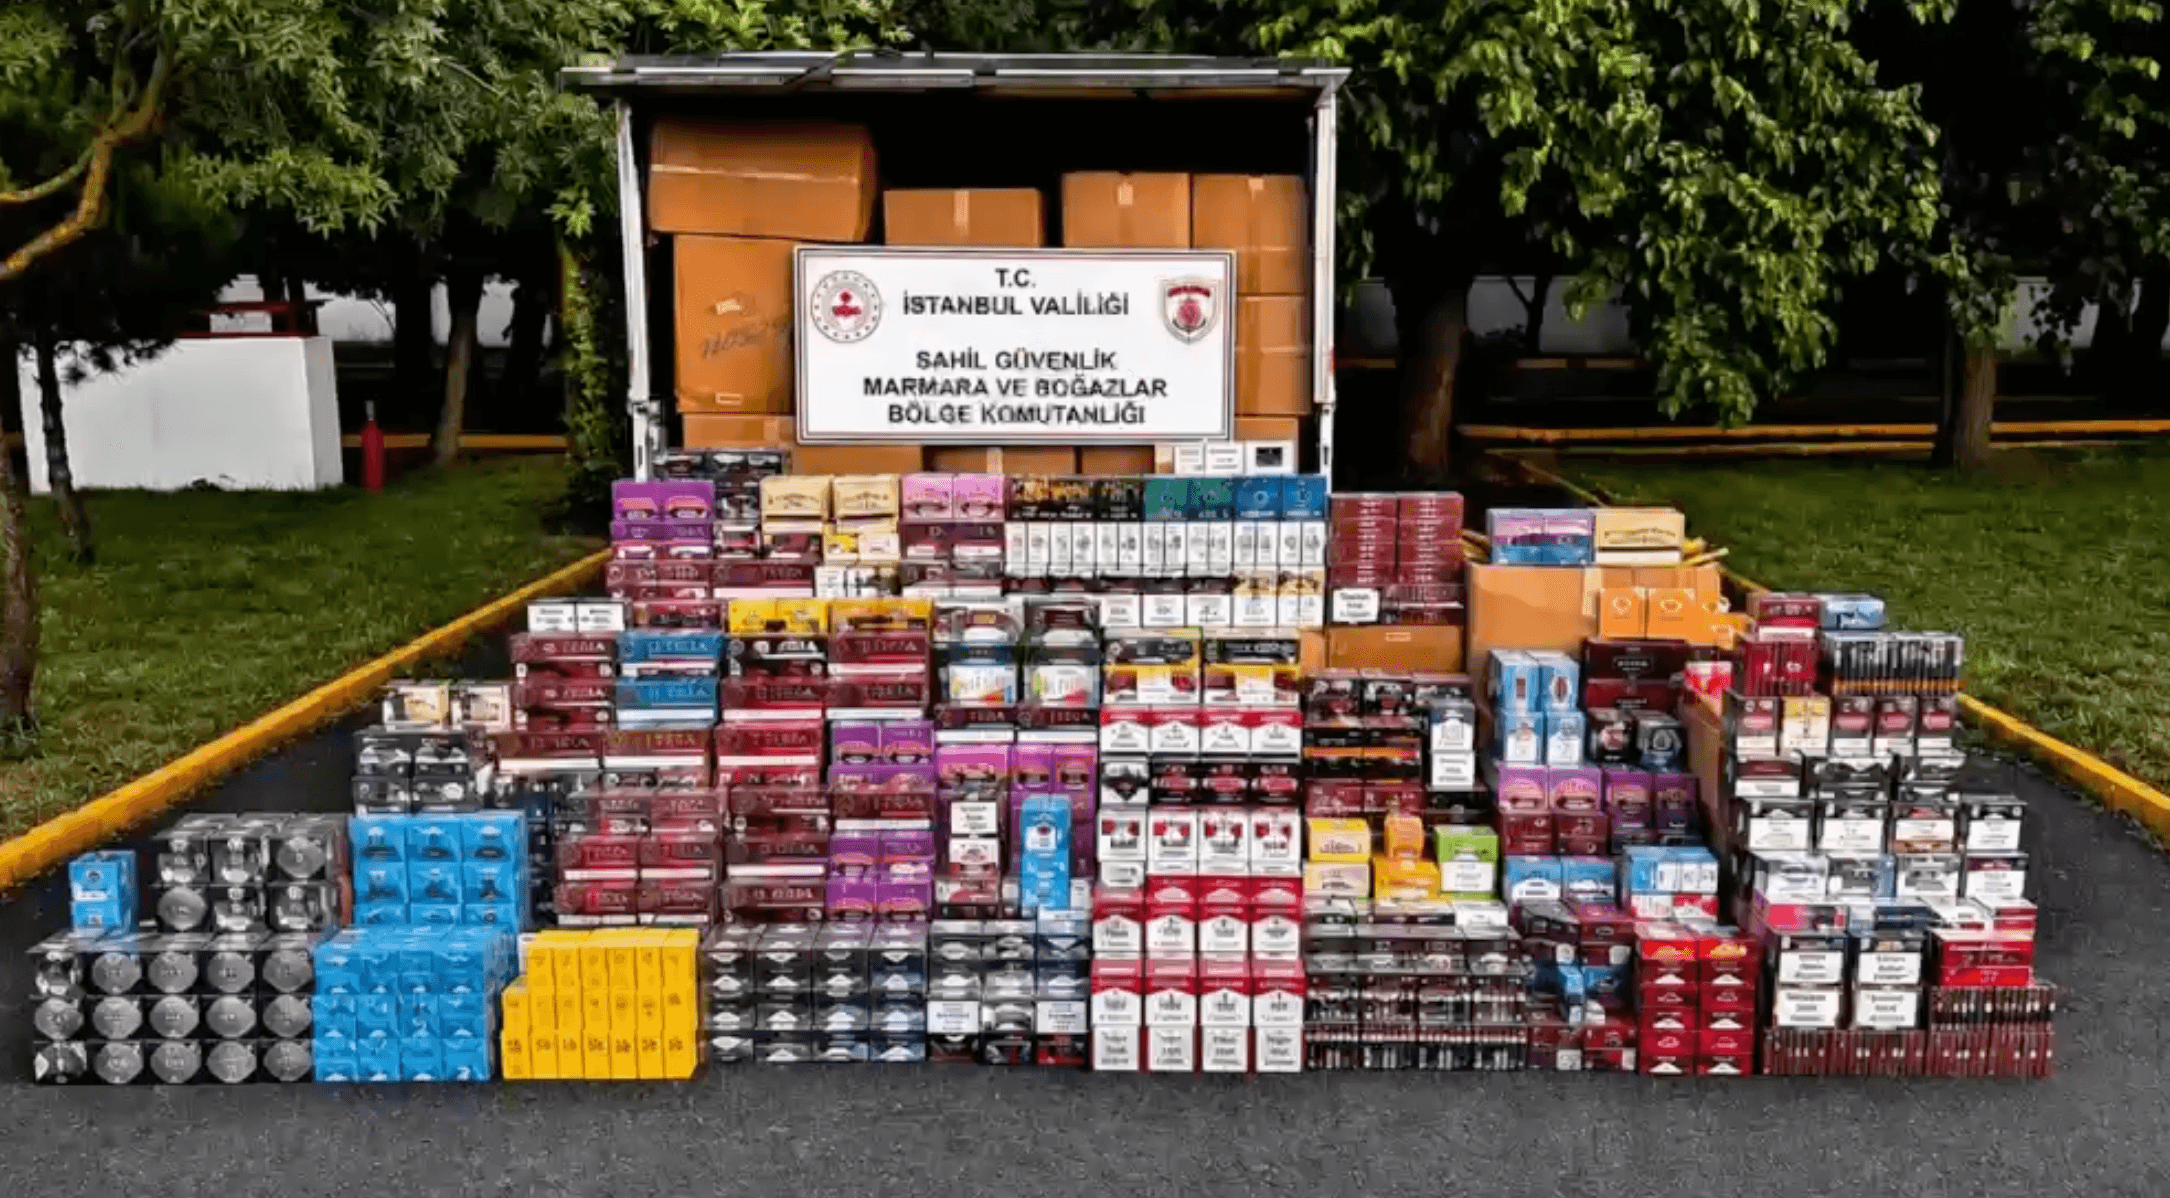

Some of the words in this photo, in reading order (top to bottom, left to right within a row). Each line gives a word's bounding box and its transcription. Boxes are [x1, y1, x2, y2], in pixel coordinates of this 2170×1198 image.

[995, 267, 1036, 289] T.C.
[902, 290, 1023, 316] İSTANBUL
[1030, 288, 1130, 316] VALİLİĞİ
[916, 347, 988, 371] SAHİL
[995, 347, 1118, 373] GÜVENLİK
[863, 377, 989, 397] MARMARA
[997, 377, 1026, 397] VE
[1035, 373, 1168, 398] BOĞAZLAR
[887, 400, 972, 426] BÖLGE
